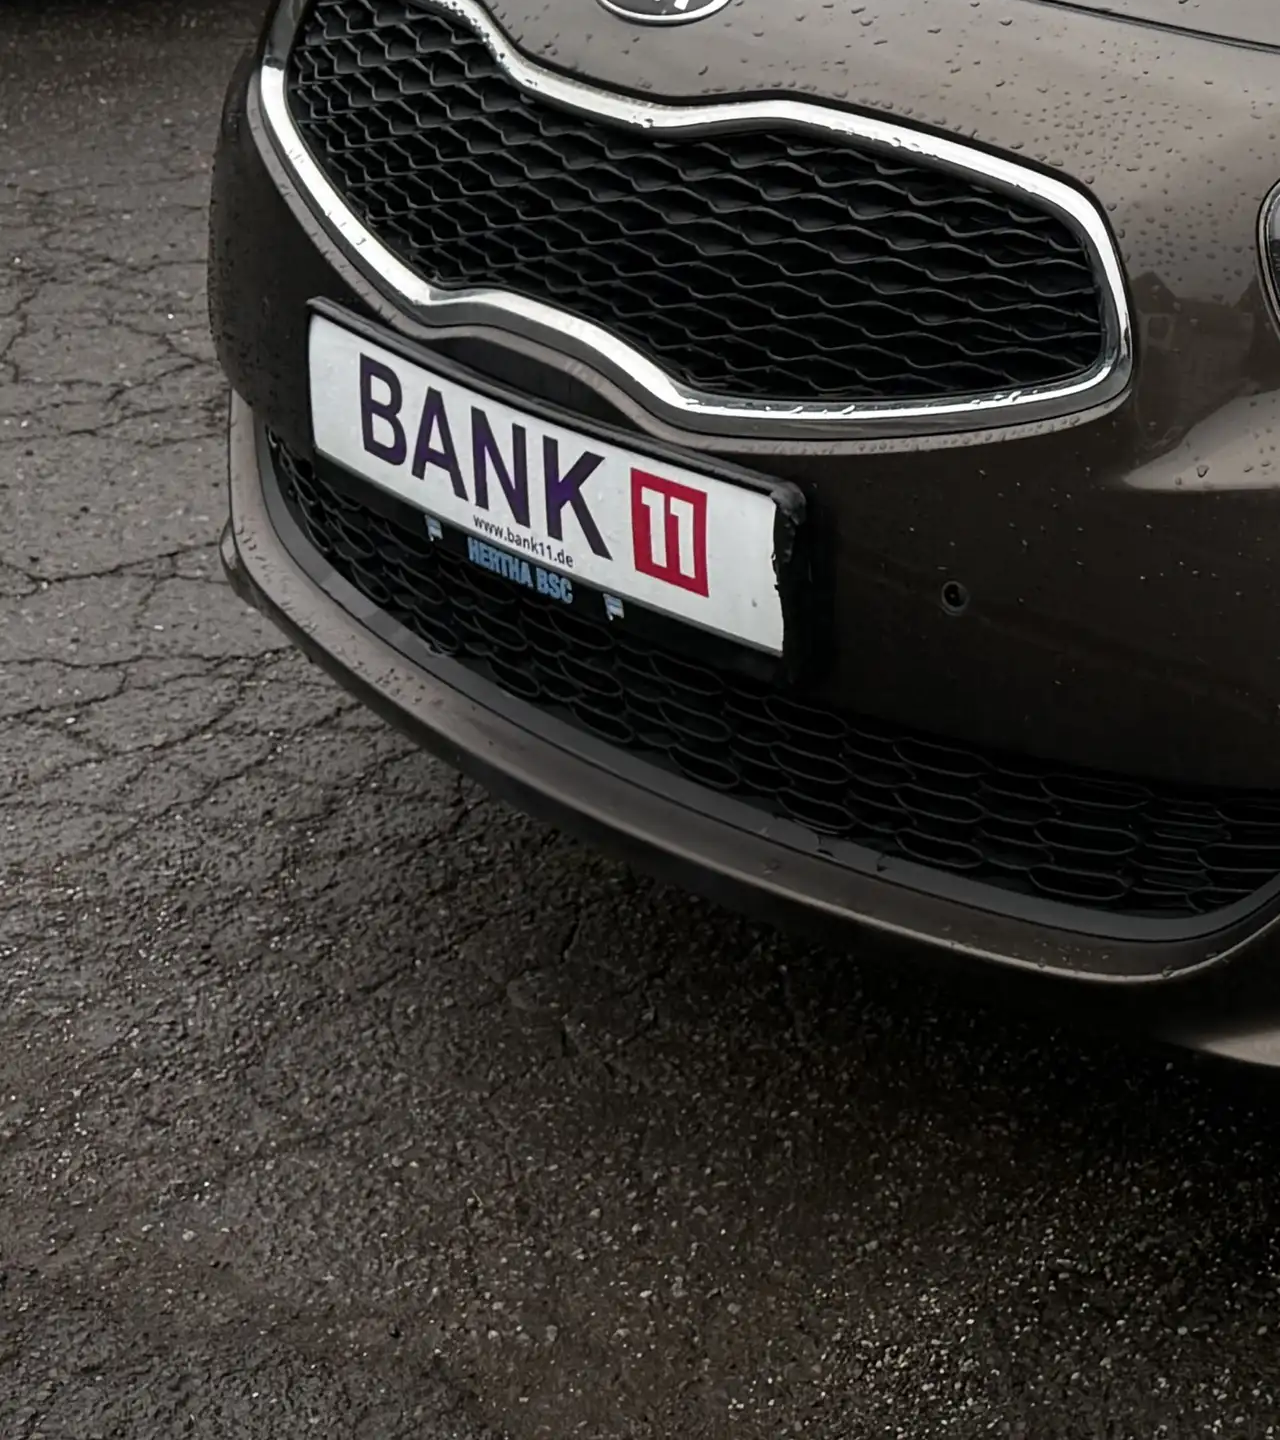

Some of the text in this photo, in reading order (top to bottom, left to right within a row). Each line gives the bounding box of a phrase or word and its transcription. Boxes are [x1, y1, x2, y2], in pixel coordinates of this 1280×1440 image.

[359, 352, 697, 580] BANK 11
[467, 536, 574, 605] HERTHA BSC
[473, 514, 574, 569] www.bank11.de
